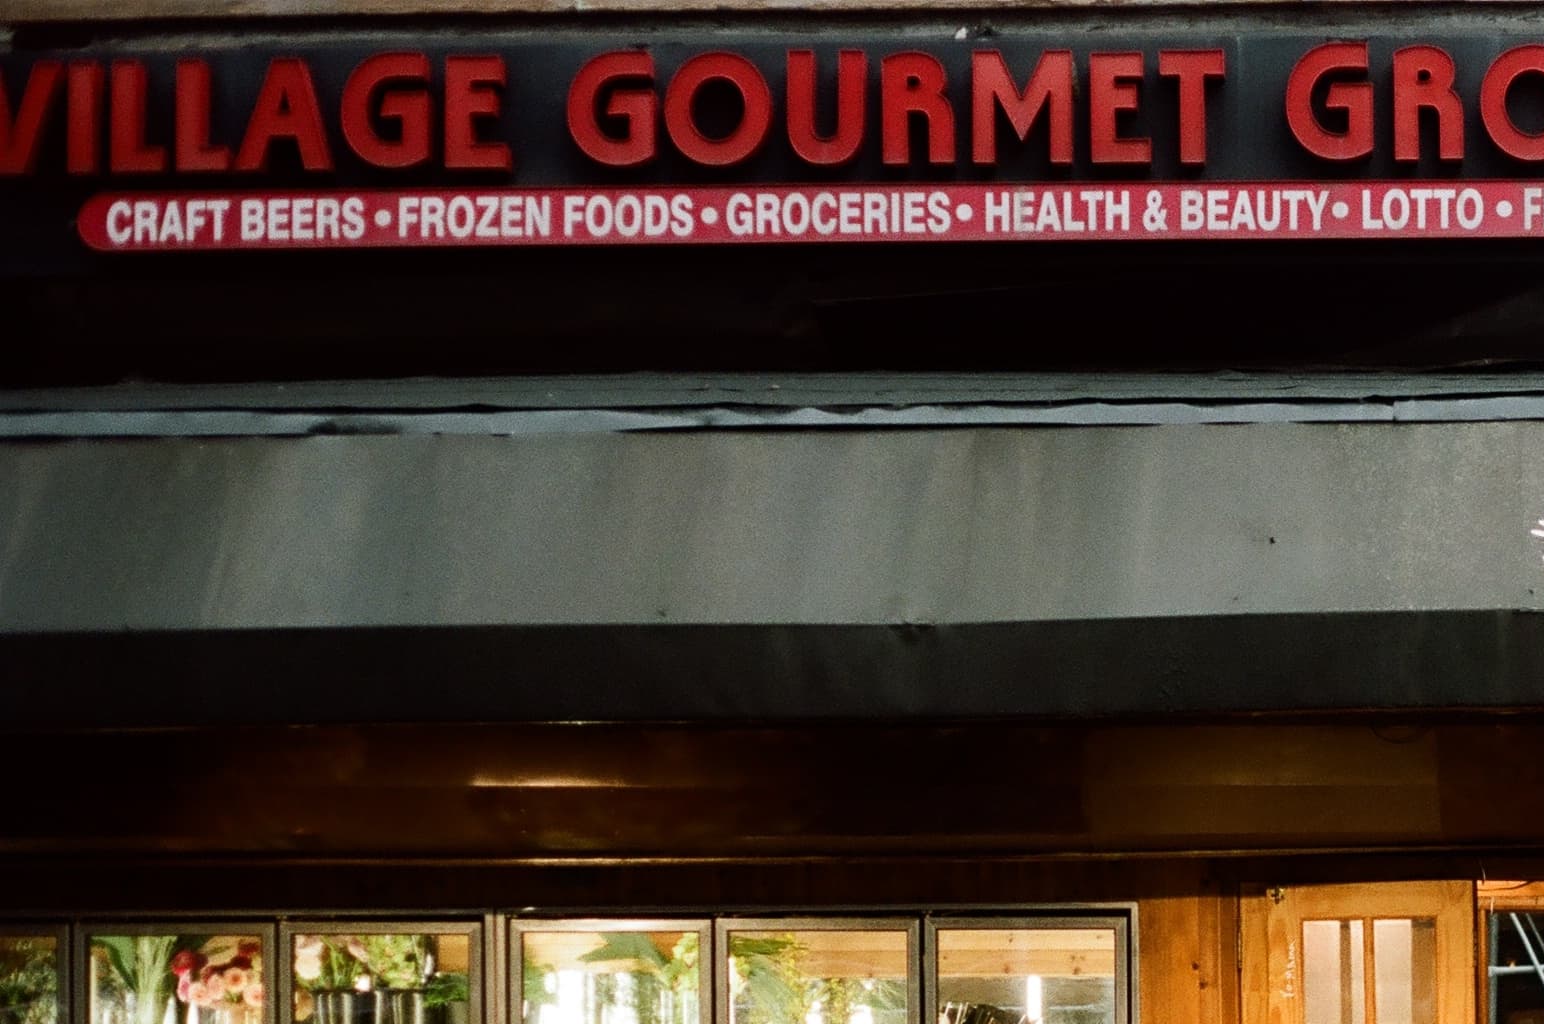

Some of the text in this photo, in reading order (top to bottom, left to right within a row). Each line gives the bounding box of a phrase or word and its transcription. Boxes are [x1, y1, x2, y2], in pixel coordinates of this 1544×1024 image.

[0, 51, 513, 175] VILLAGE
[566, 48, 1226, 168] GOURMET
[106, 200, 229, 242] CRAFT
[239, 198, 365, 241] BEERS
[398, 197, 552, 239] FROZEN
[563, 195, 695, 238] FOODS
[725, 194, 952, 237] GROCERIES
[984, 192, 1136, 234] HEALTH
[1142, 191, 1167, 232] &
[1190, 190, 1331, 232] BEAUTY
[1361, 189, 1484, 231] LOTTO
